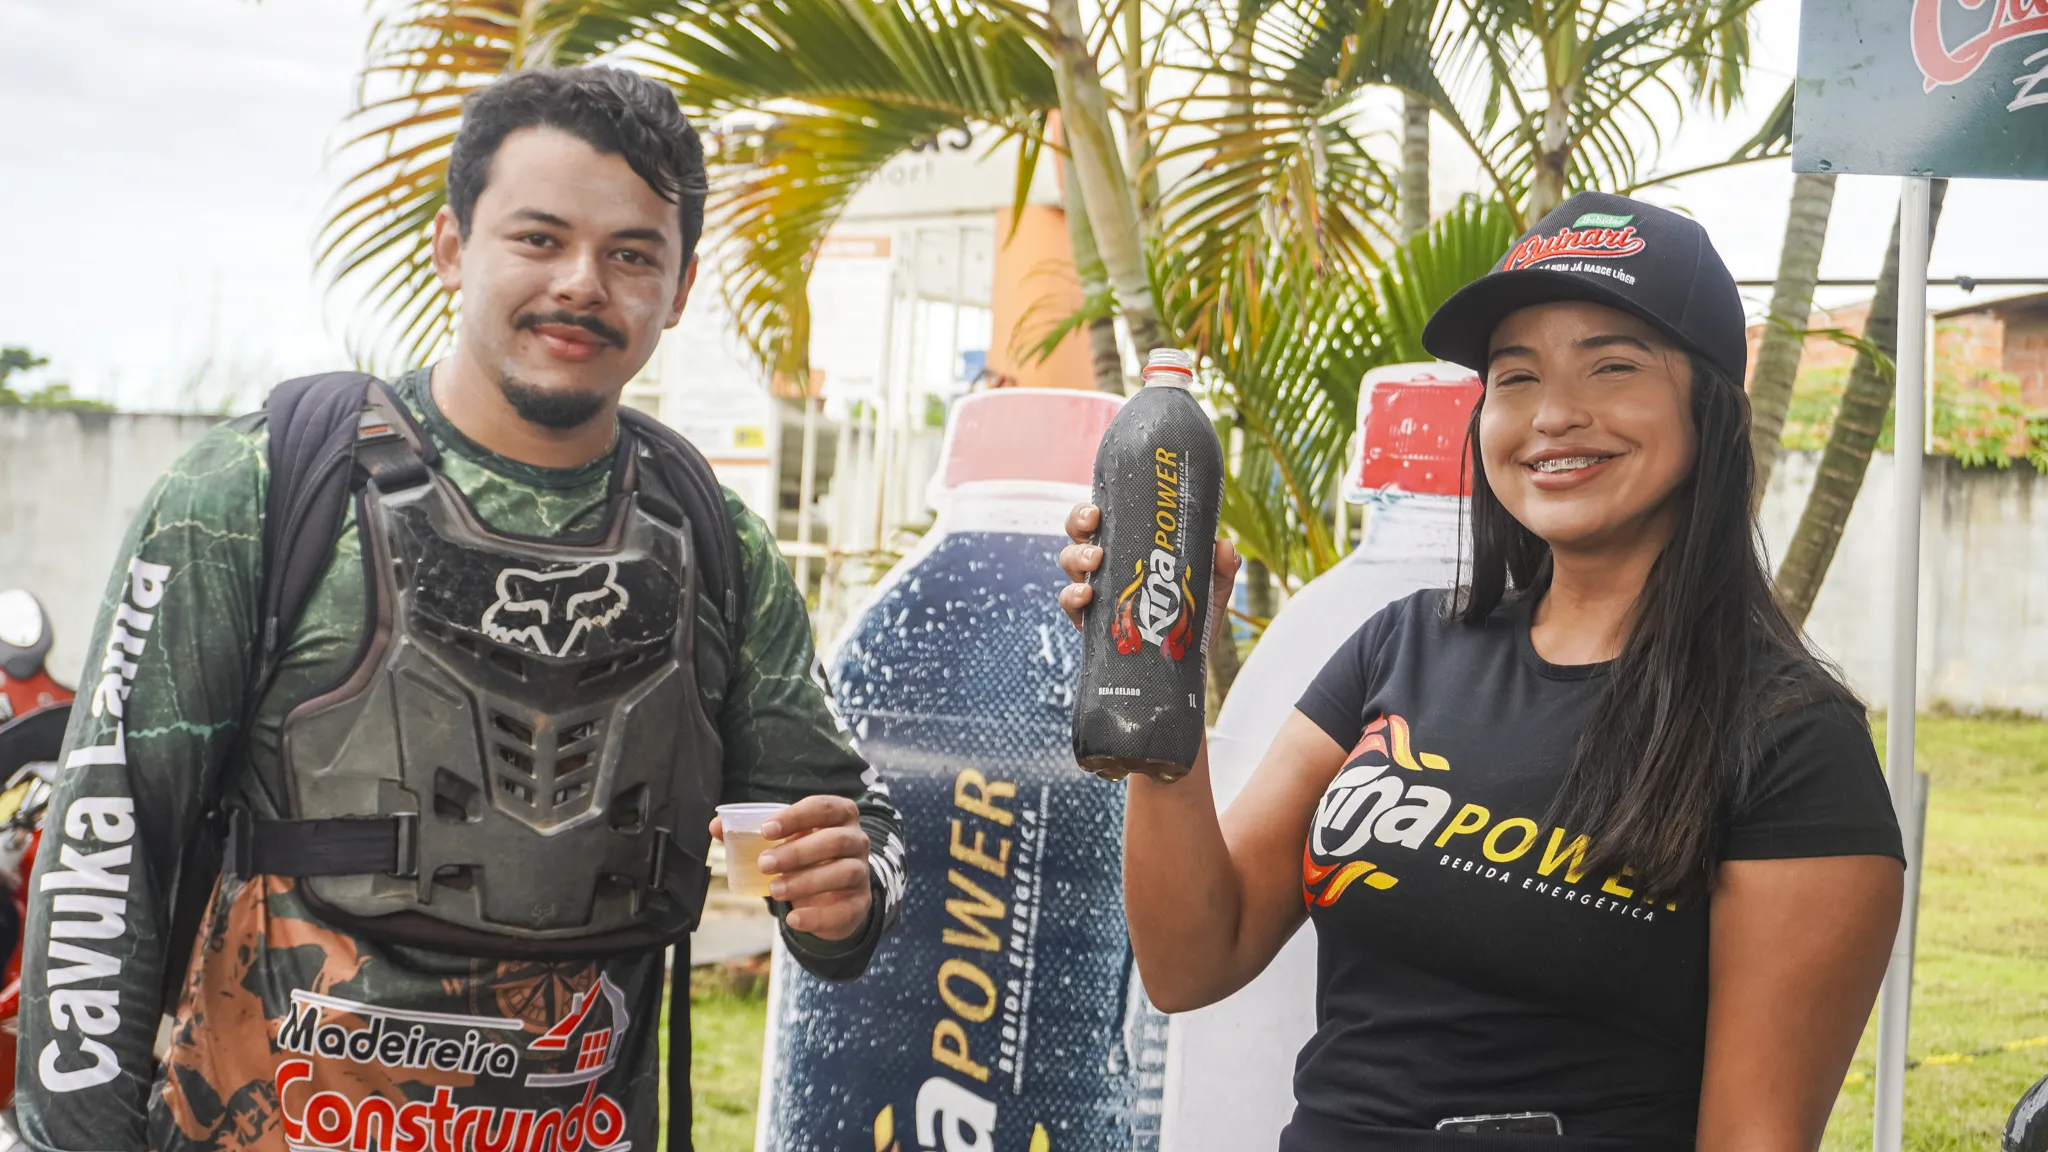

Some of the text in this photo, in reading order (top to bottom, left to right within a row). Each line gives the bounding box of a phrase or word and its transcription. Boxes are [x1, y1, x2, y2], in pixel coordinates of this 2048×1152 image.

[1570, 260, 1583, 272] JÁ
[1583, 263, 1611, 277] NASCE
[1612, 268, 1636, 286] LÍDER
[1154, 447, 1178, 552] POWER
[1176, 518, 1184, 549] BEBIDA
[1098, 687, 1141, 697] BEBA GELADO
[1187, 692, 1197, 709] 1L
[38, 557, 172, 1093] Cavuka Lama
[1434, 803, 1677, 912] POWE
[931, 767, 1018, 1084] POWER
[1008, 809, 1038, 969] ENERGÉTICA
[1440, 854, 1655, 922] BEBIDA ENERGÉTICA
[277, 998, 518, 1078] Madeireira
[998, 978, 1022, 1074] BEBIDA
[275, 1058, 625, 1152] Construindo
